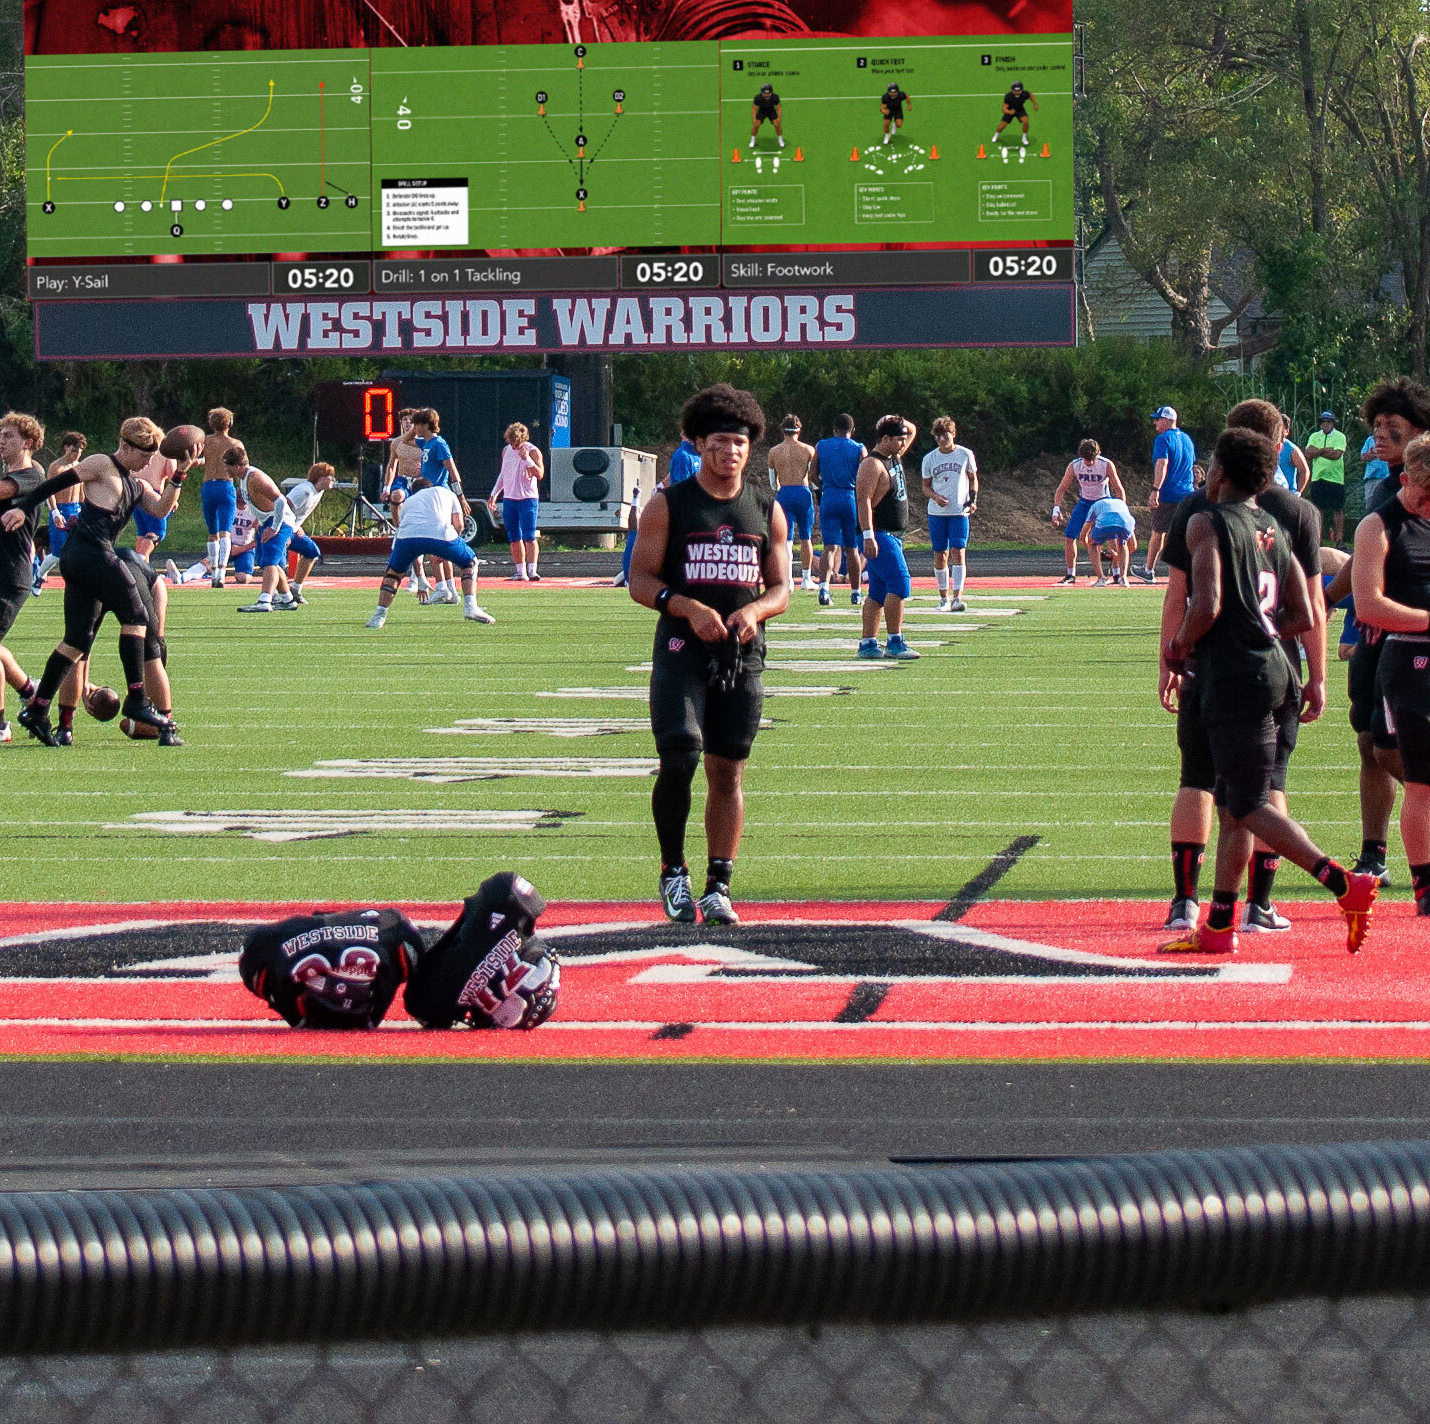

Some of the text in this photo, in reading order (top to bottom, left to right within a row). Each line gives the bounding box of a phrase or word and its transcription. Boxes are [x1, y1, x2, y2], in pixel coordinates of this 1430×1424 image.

[350, 84, 363, 104] 40
[397, 105, 411, 130] 40
[381, 267, 521, 284] Drill: 1 on 1 Tackling
[636, 261, 703, 283] 05:20
[731, 262, 834, 277] Skill: Footwork
[989, 255, 1057, 277] 05:20
[36, 275, 109, 292] Play: Y-Sail
[287, 268, 354, 288] 05:20
[247, 294, 856, 351] WESTSIDE WARRIORS
[365, 387, 393, 439] 0
[232, 517, 252, 527] REP
[687, 543, 758, 564] WESTSIDE
[685, 562, 759, 583] WIDEOUTS
[282, 924, 380, 957] WESTSIDE
[457, 928, 522, 1006] WESTSIDE
